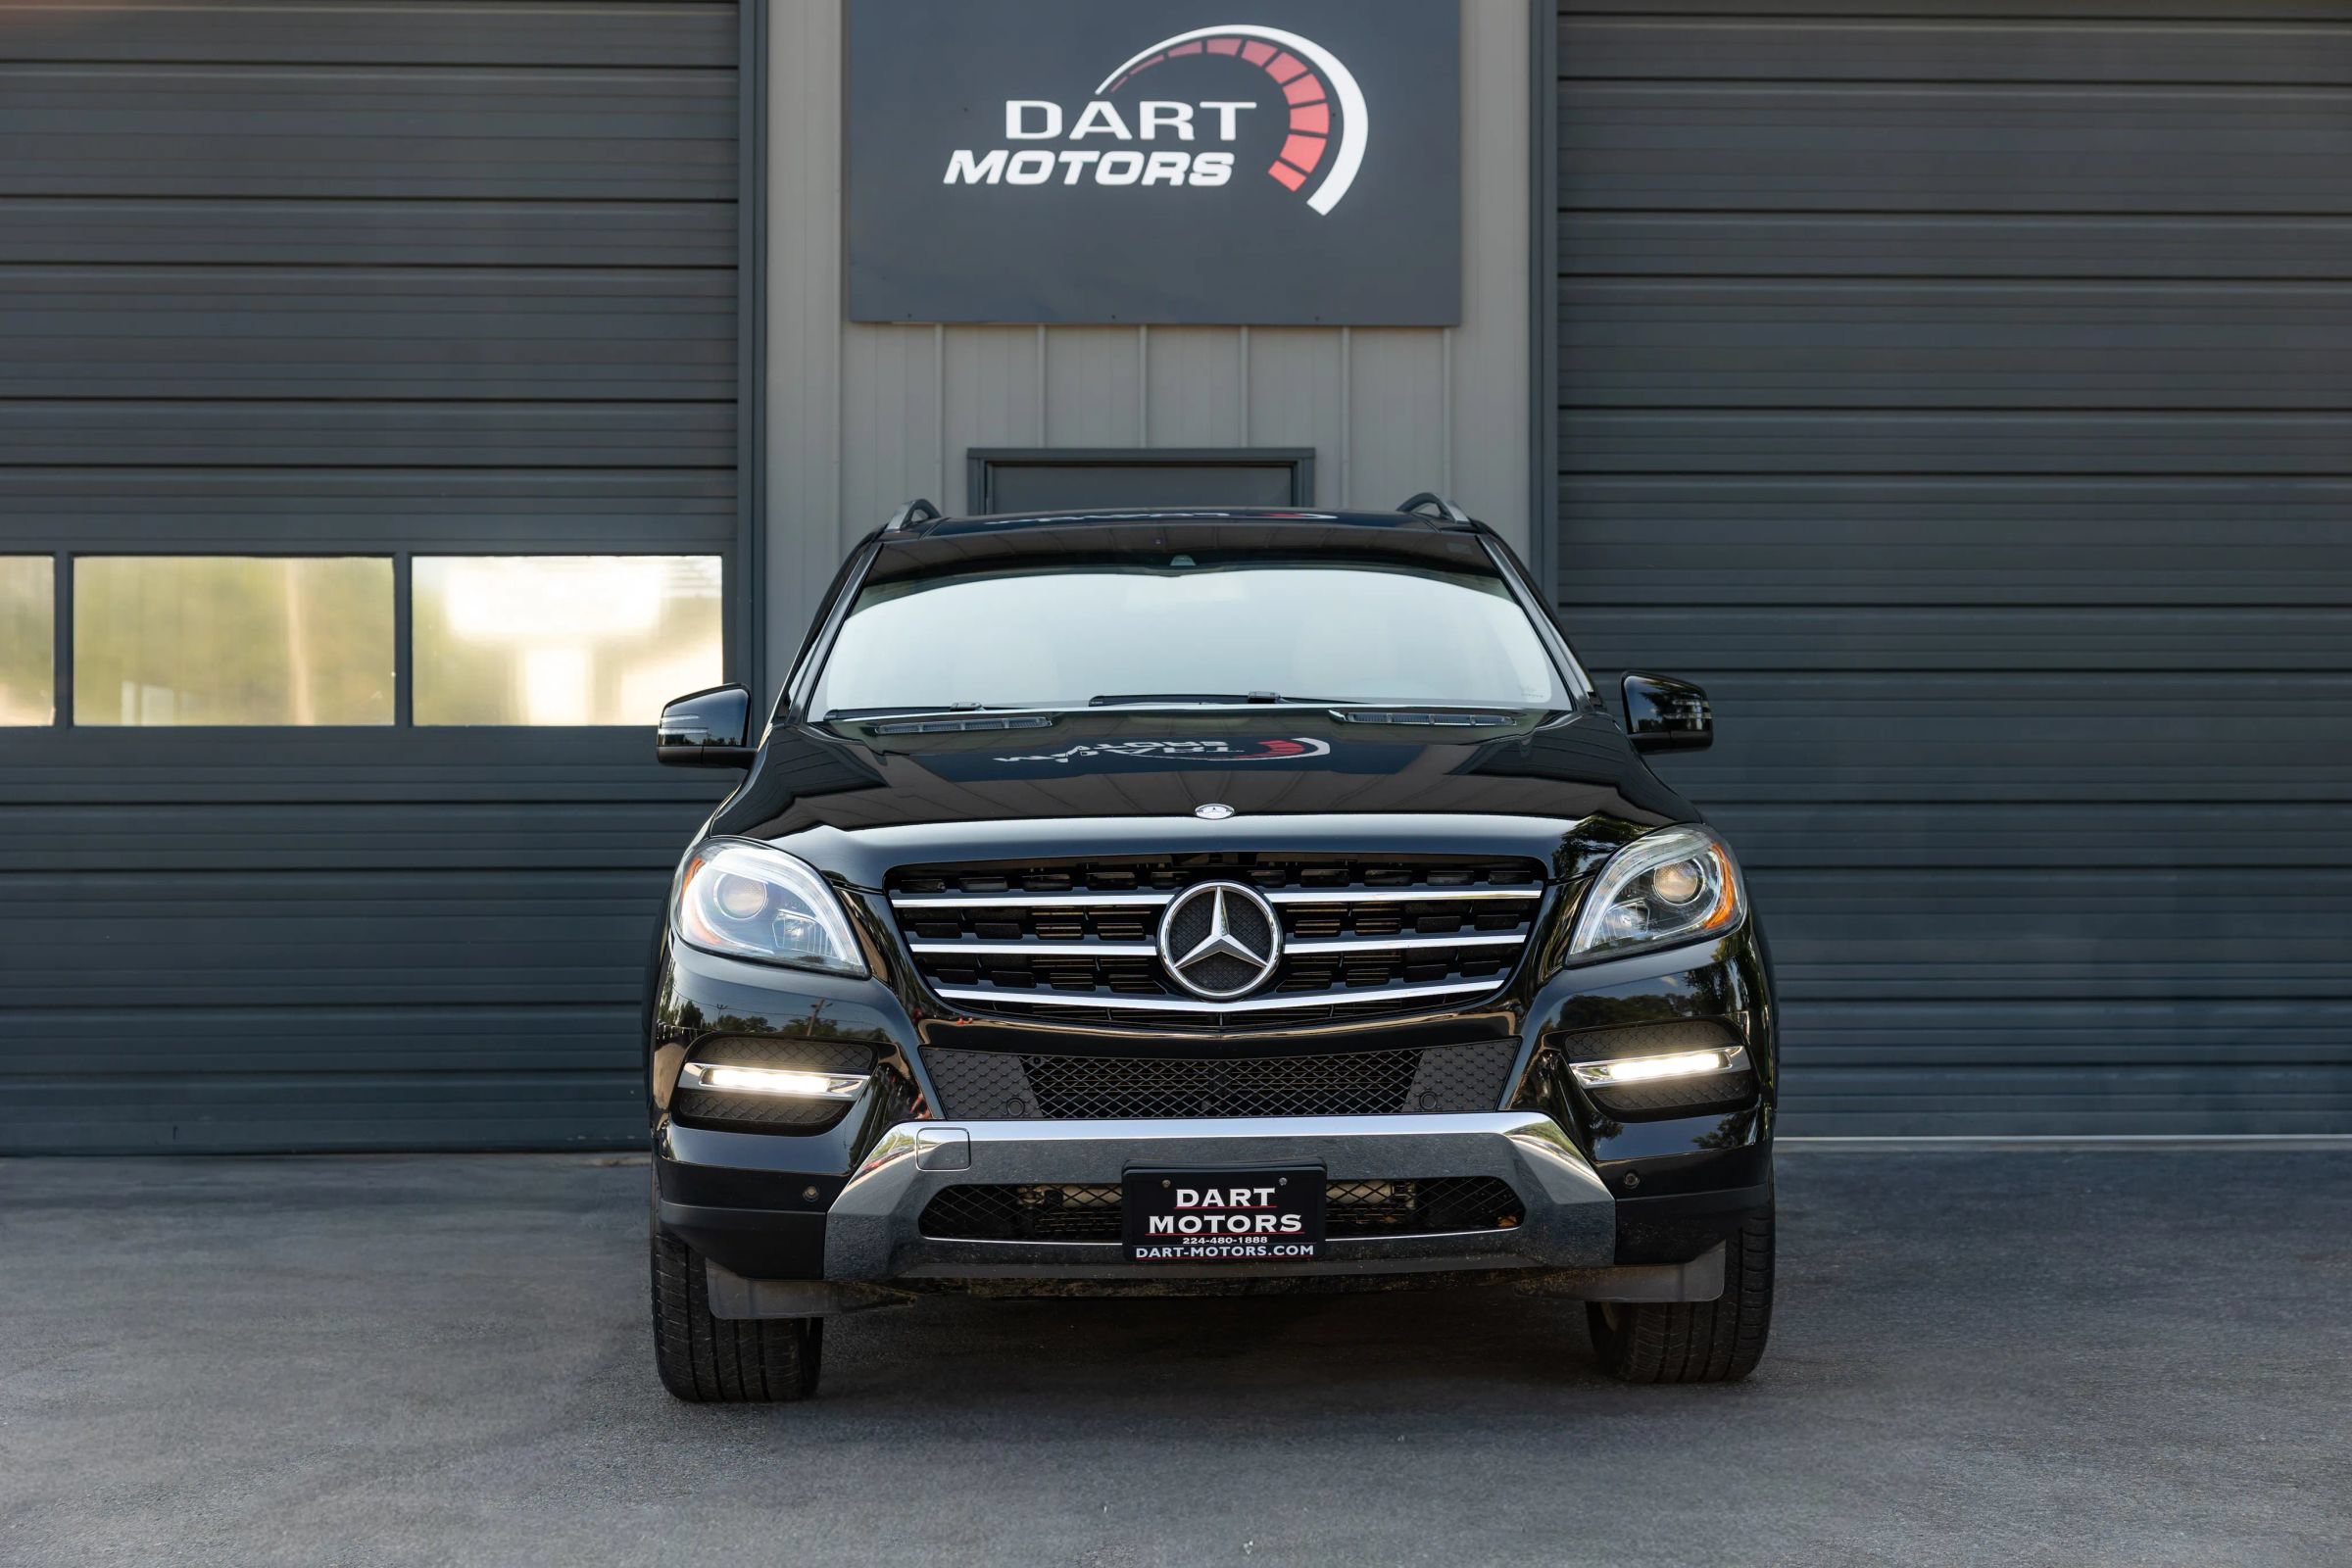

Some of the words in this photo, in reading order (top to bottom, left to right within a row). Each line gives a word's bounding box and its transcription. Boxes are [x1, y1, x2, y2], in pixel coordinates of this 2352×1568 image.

[1005, 100, 1257, 141] DART
[943, 149, 1235, 186] MOTORS
[1176, 1187, 1276, 1207] DART
[1149, 1213, 1302, 1234] MOTORS
[1182, 1236, 1268, 1245] 224-480-1888
[1136, 1245, 1314, 1258] DART-MOTORS.COM
